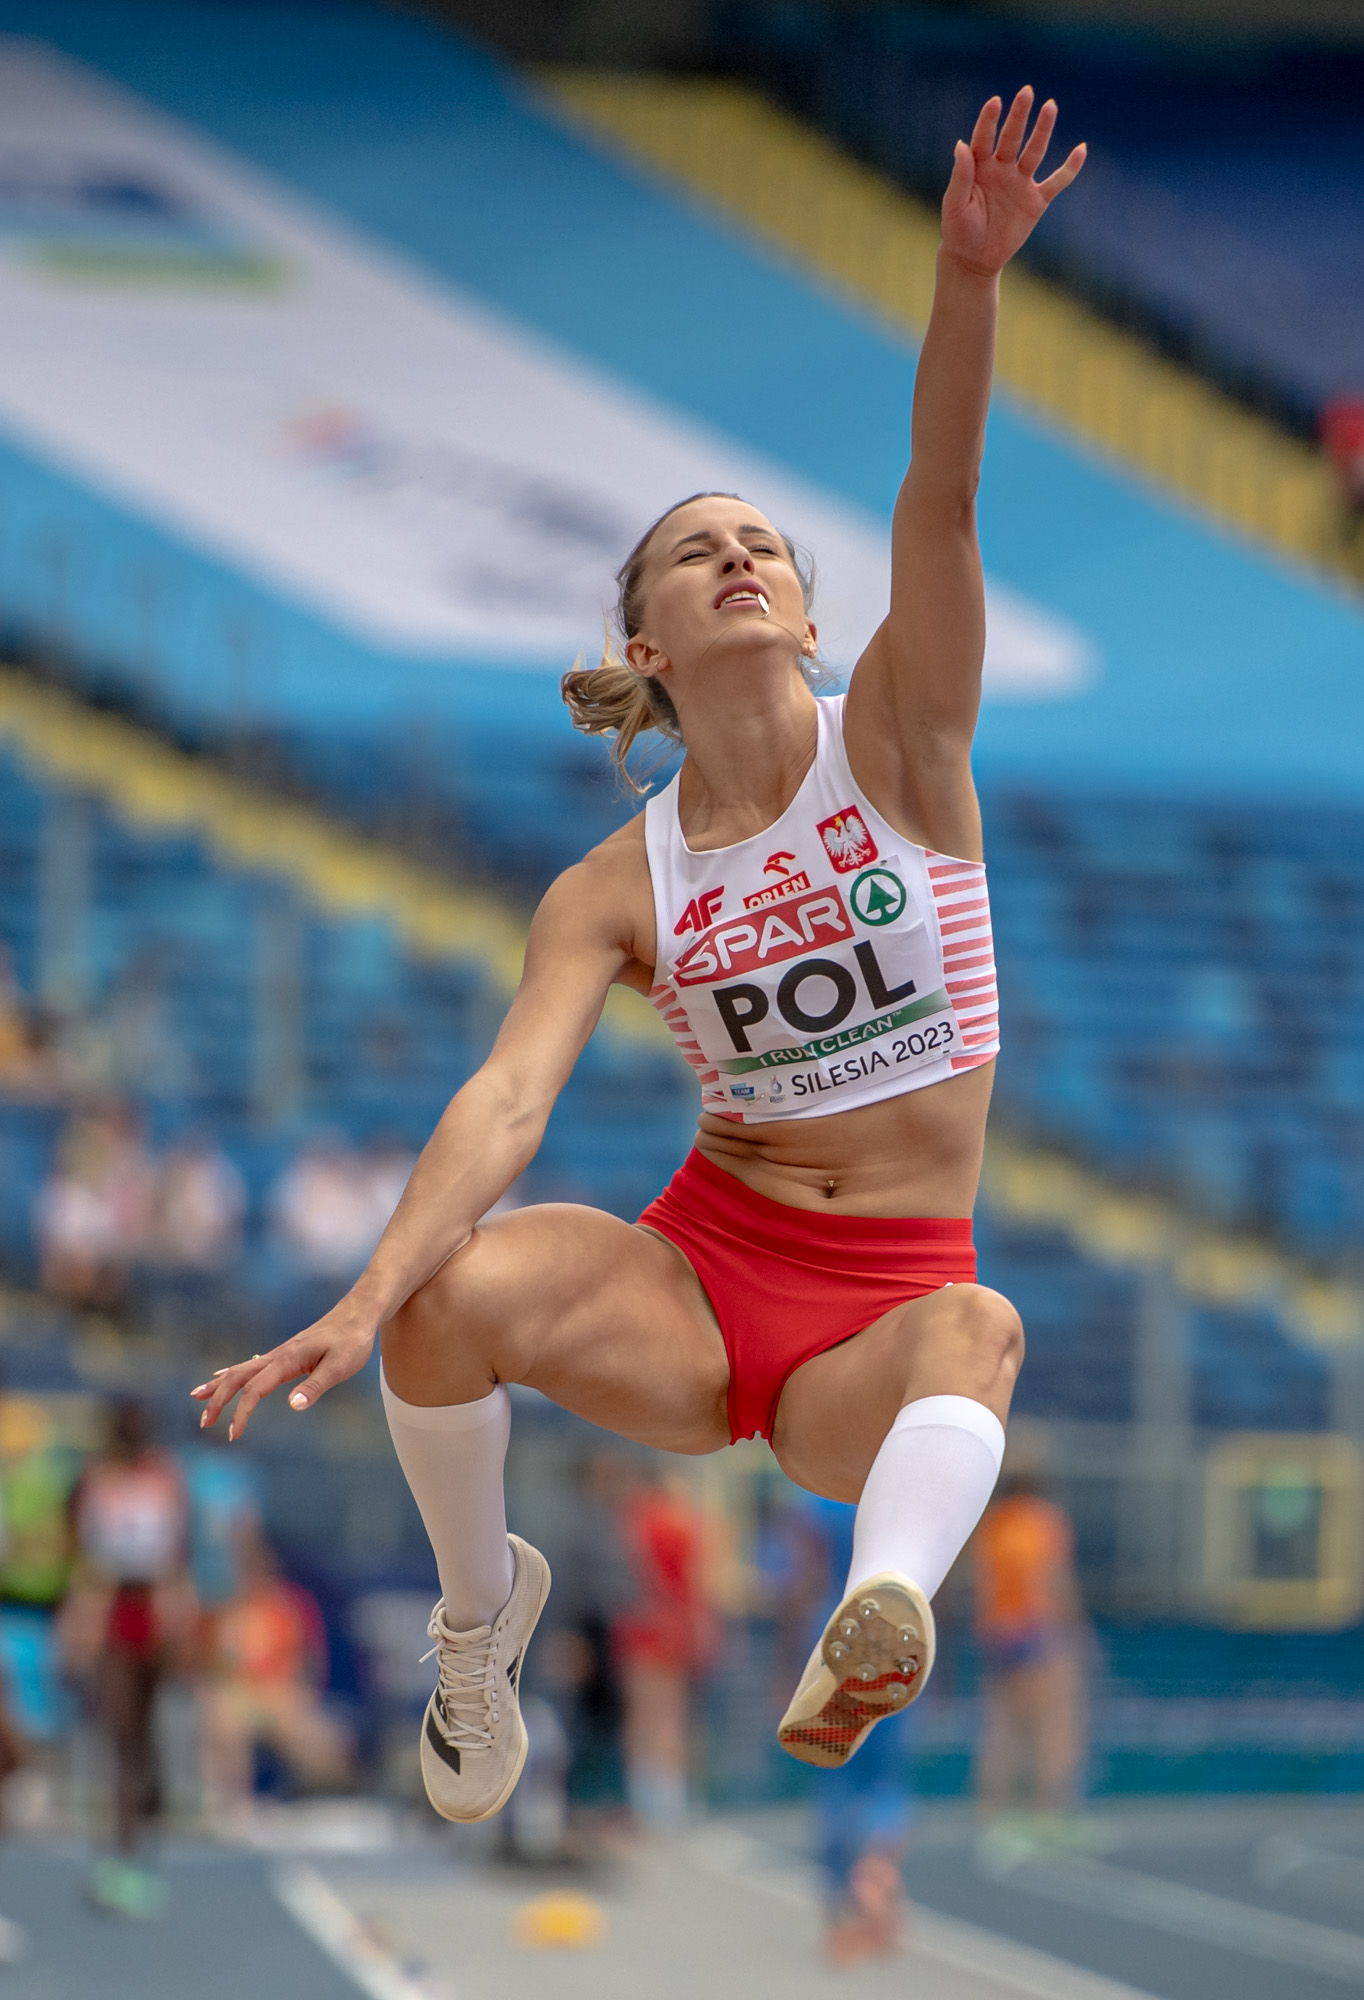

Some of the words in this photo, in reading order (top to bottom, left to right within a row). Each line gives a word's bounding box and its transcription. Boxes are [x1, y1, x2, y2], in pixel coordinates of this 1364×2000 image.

[748, 876, 807, 908] ORLEN
[679, 896, 847, 980] SPAR
[712, 939, 917, 1053] POL
[759, 1057, 769, 1067] I
[769, 1043, 818, 1063] RUN
[791, 1051, 890, 1096] SILESIA
[892, 1021, 954, 1063] 2023
